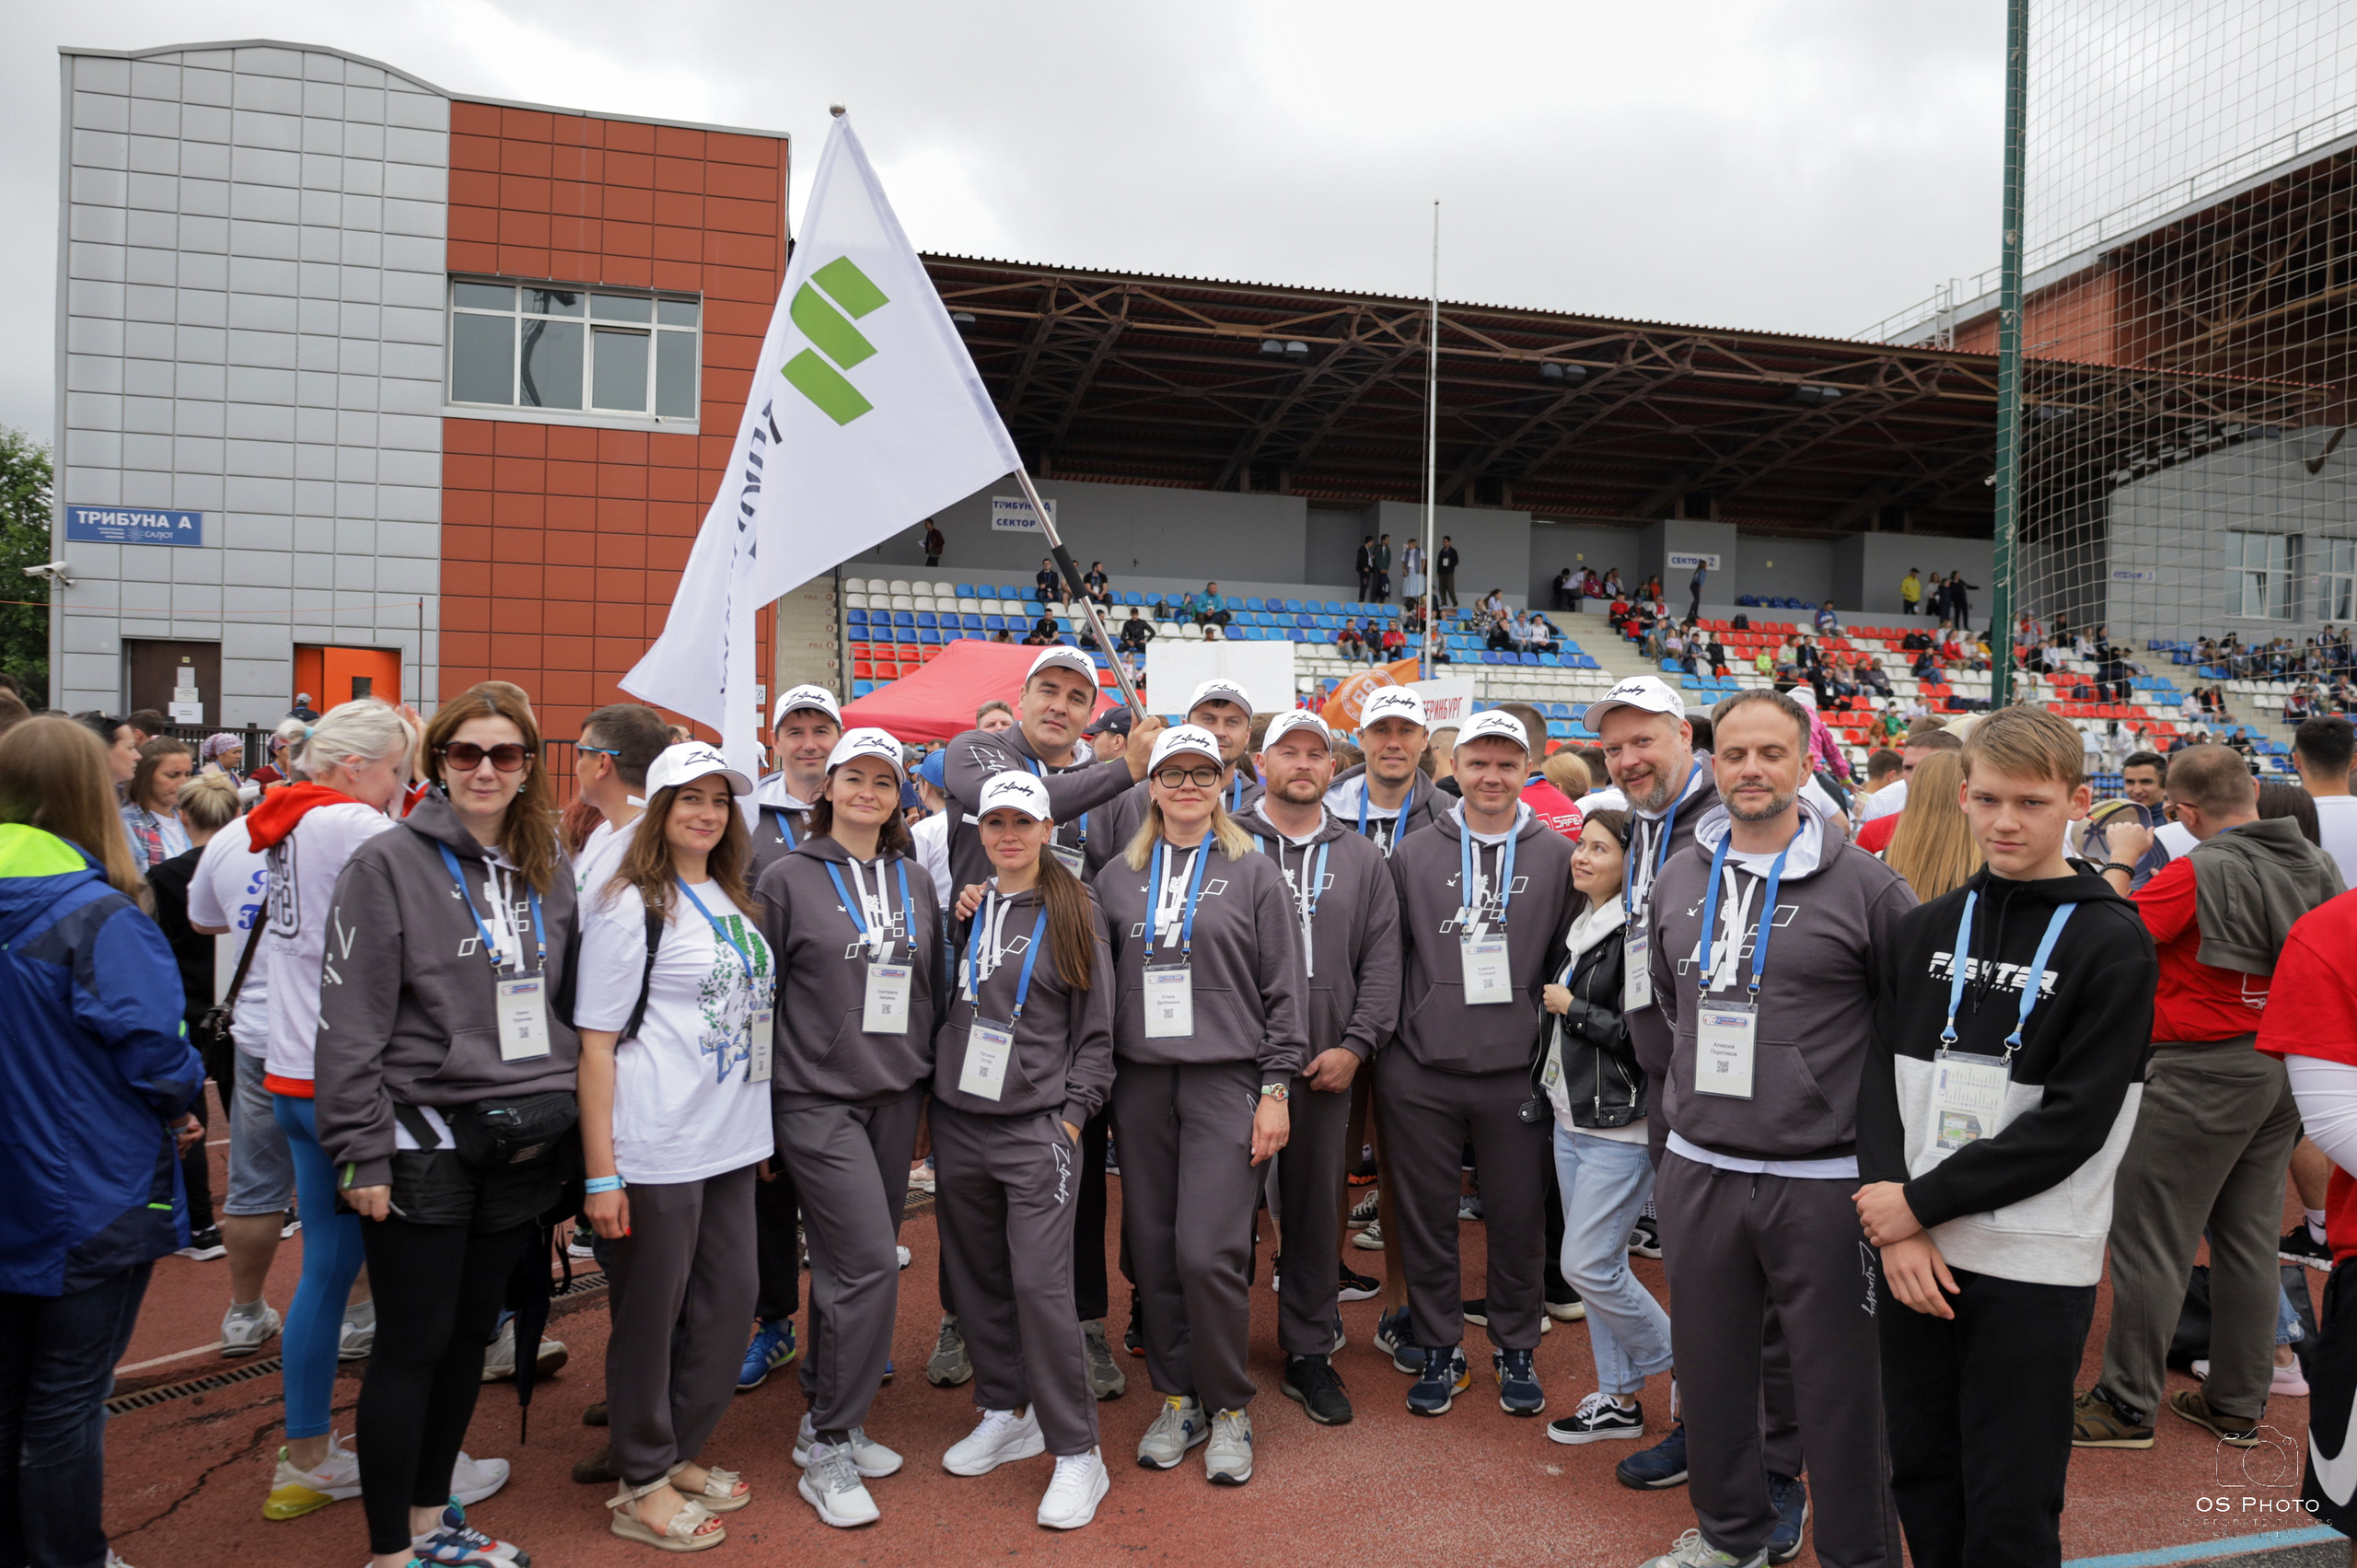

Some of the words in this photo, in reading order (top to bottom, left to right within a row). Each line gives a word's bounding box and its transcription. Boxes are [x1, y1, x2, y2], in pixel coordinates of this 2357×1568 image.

[76, 510, 170, 528] ТРИБУНА
[178, 516, 192, 528] А
[996, 518, 1036, 527] СЕКТОР
[1671, 556, 1702, 564] СЕКТО
[1709, 557, 1714, 566] 2
[1713, 1041, 1736, 1051] Алексей
